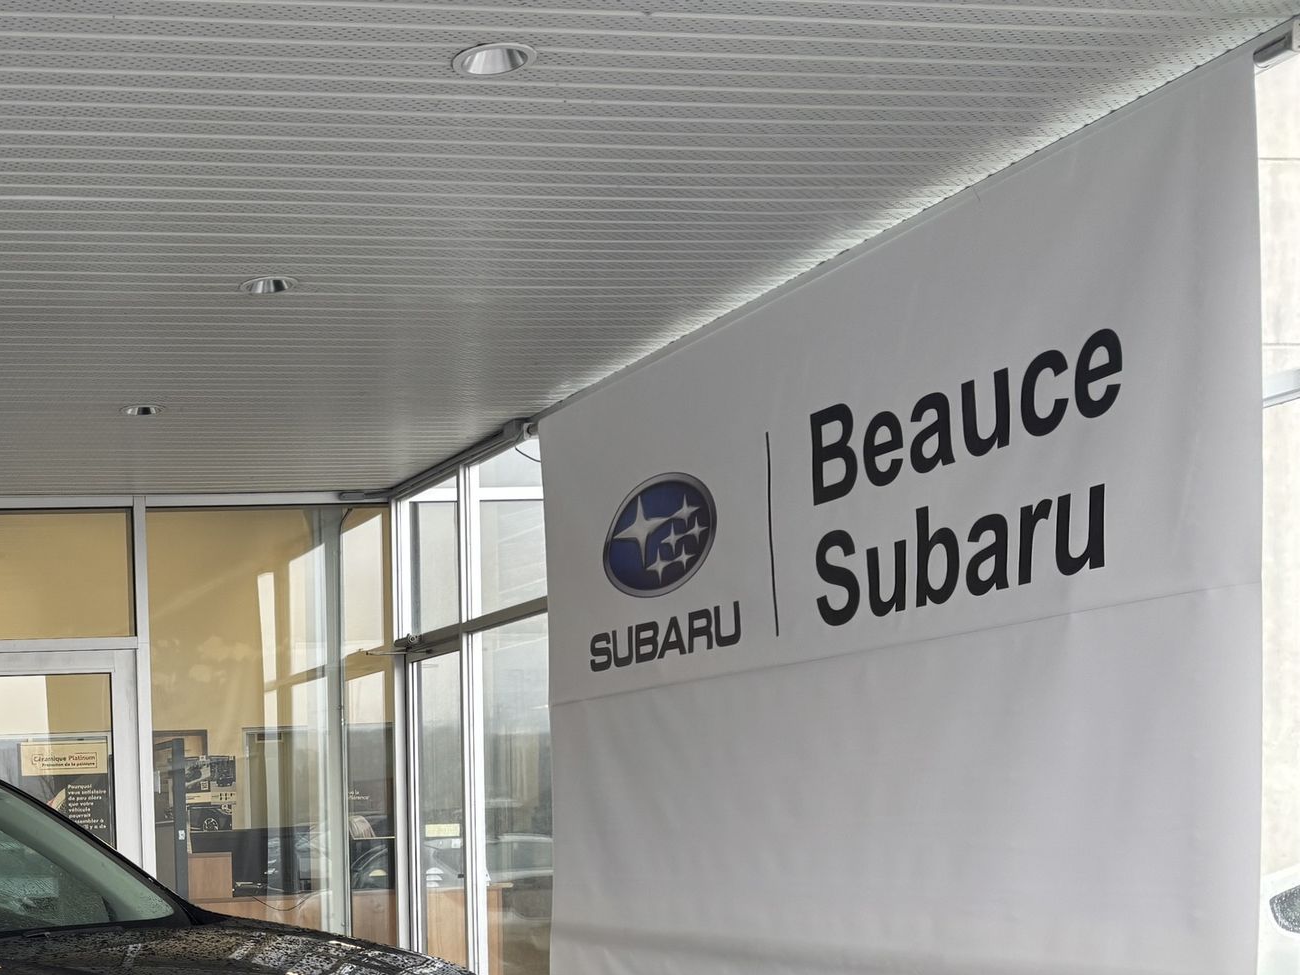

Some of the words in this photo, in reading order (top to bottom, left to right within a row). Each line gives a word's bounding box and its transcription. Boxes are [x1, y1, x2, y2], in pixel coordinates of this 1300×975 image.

[810, 328, 1122, 506] Beauce
[815, 483, 1105, 626] Subaru
[589, 600, 742, 673] SUBARU
